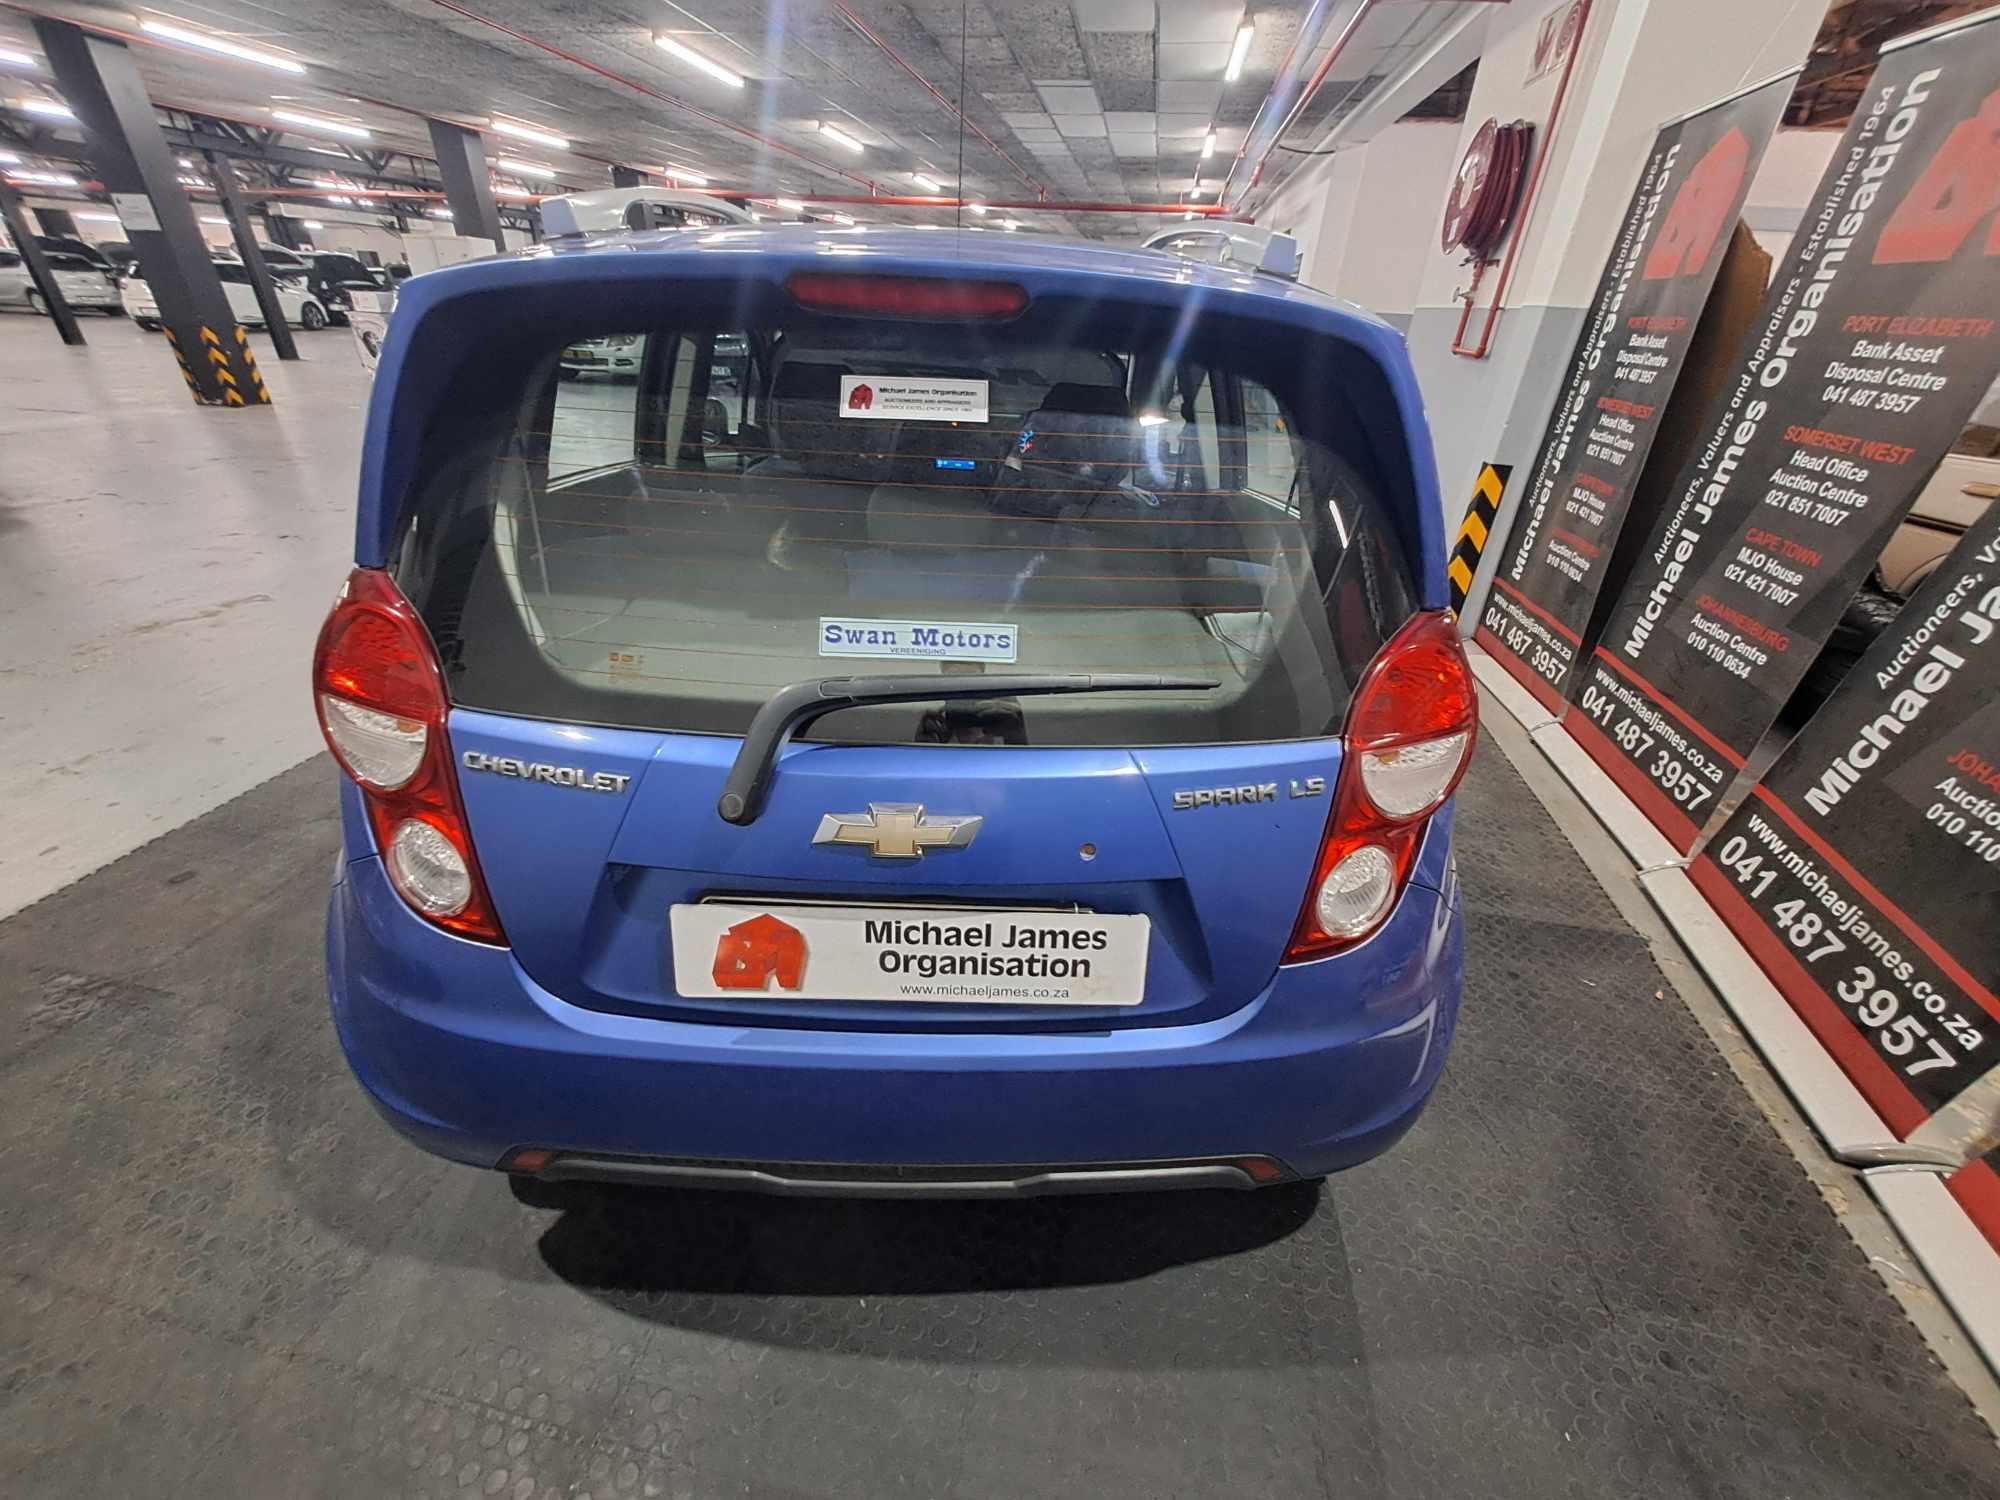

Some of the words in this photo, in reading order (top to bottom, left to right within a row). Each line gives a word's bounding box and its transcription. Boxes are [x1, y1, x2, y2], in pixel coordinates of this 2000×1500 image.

[1653, 474, 1704, 565] Auctioneers,
[1697, 410, 1734, 470] Valuers
[1731, 374, 1752, 408] and
[1748, 278, 1800, 372] Appraisers
[1801, 146, 1865, 261] Established
[1859, 85, 1896, 141] 1964
[1511, 478, 1554, 581] Michael
[1551, 379, 1590, 474] James
[1588, 143, 1681, 371] Organisation
[1624, 528, 1700, 659] Michael
[1694, 399, 1768, 524] James
[1760, 67, 1943, 388] Organisation
[1851, 340, 1892, 360] Bank
[1889, 342, 1945, 363] Asset
[1572, 361, 1585, 388] and
[1824, 361, 1889, 383] Disposal
[1887, 368, 1947, 391] Centre
[1822, 385, 1849, 403] 041
[1849, 389, 1878, 407] 487
[1874, 393, 1921, 413] 3957
[1783, 425, 1861, 453] SOMERSET
[1859, 440, 1915, 464] WEST
[1789, 450, 1827, 471] Head
[1825, 457, 1869, 482] Office
[1765, 489, 1787, 508] 021
[1787, 496, 1813, 516] 851
[1811, 502, 1850, 527] 7007
[1769, 468, 1818, 494] Auction
[1818, 482, 1868, 508] Centre
[1737, 546, 1766, 569] MJO
[1764, 558, 1804, 586] House
[1744, 527, 1781, 549] CAPE
[1782, 539, 1823, 568] TOWN
[1724, 564, 1747, 583] 021
[1745, 574, 1768, 593] 421
[1765, 583, 1799, 607] 7007
[824, 624, 897, 645] Swan
[911, 627, 1011, 649] Motors
[1485, 607, 1508, 636] 041
[1506, 626, 1533, 655] 487
[1531, 645, 1567, 684] 3957
[1691, 612, 1731, 645] Auction
[1730, 635, 1768, 666] Centre
[1875, 573, 1983, 690] Auctioneers,
[1687, 631, 1707, 651] 010
[1707, 643, 1726, 662] 110
[1723, 654, 1752, 680] 0634
[1595, 667, 1724, 784] www.michaeljames.co.za
[1803, 644, 1966, 817] Michael
[1581, 686, 1616, 727] 041
[1614, 717, 1655, 758] 487
[1650, 750, 1713, 811] 3957
[462, 751, 633, 794] CHEVROLET
[1172, 781, 1280, 811] SPARK
[1289, 777, 1327, 799] LS
[1933, 776, 2000, 831] Auctio
[1926, 803, 1966, 835] 010
[1965, 830, 2000, 862] 110
[864, 919, 992, 949] Michael
[1001, 924, 1108, 951] James
[1748, 813, 1984, 1051] www.michaeljames.co.za
[878, 949, 1091, 979] Organisation
[1719, 835, 1778, 899] 041
[1772, 898, 1846, 963] 487
[1836, 965, 1958, 1076] 3957
[900, 983, 1070, 1000] www.michaeljames.co.za
